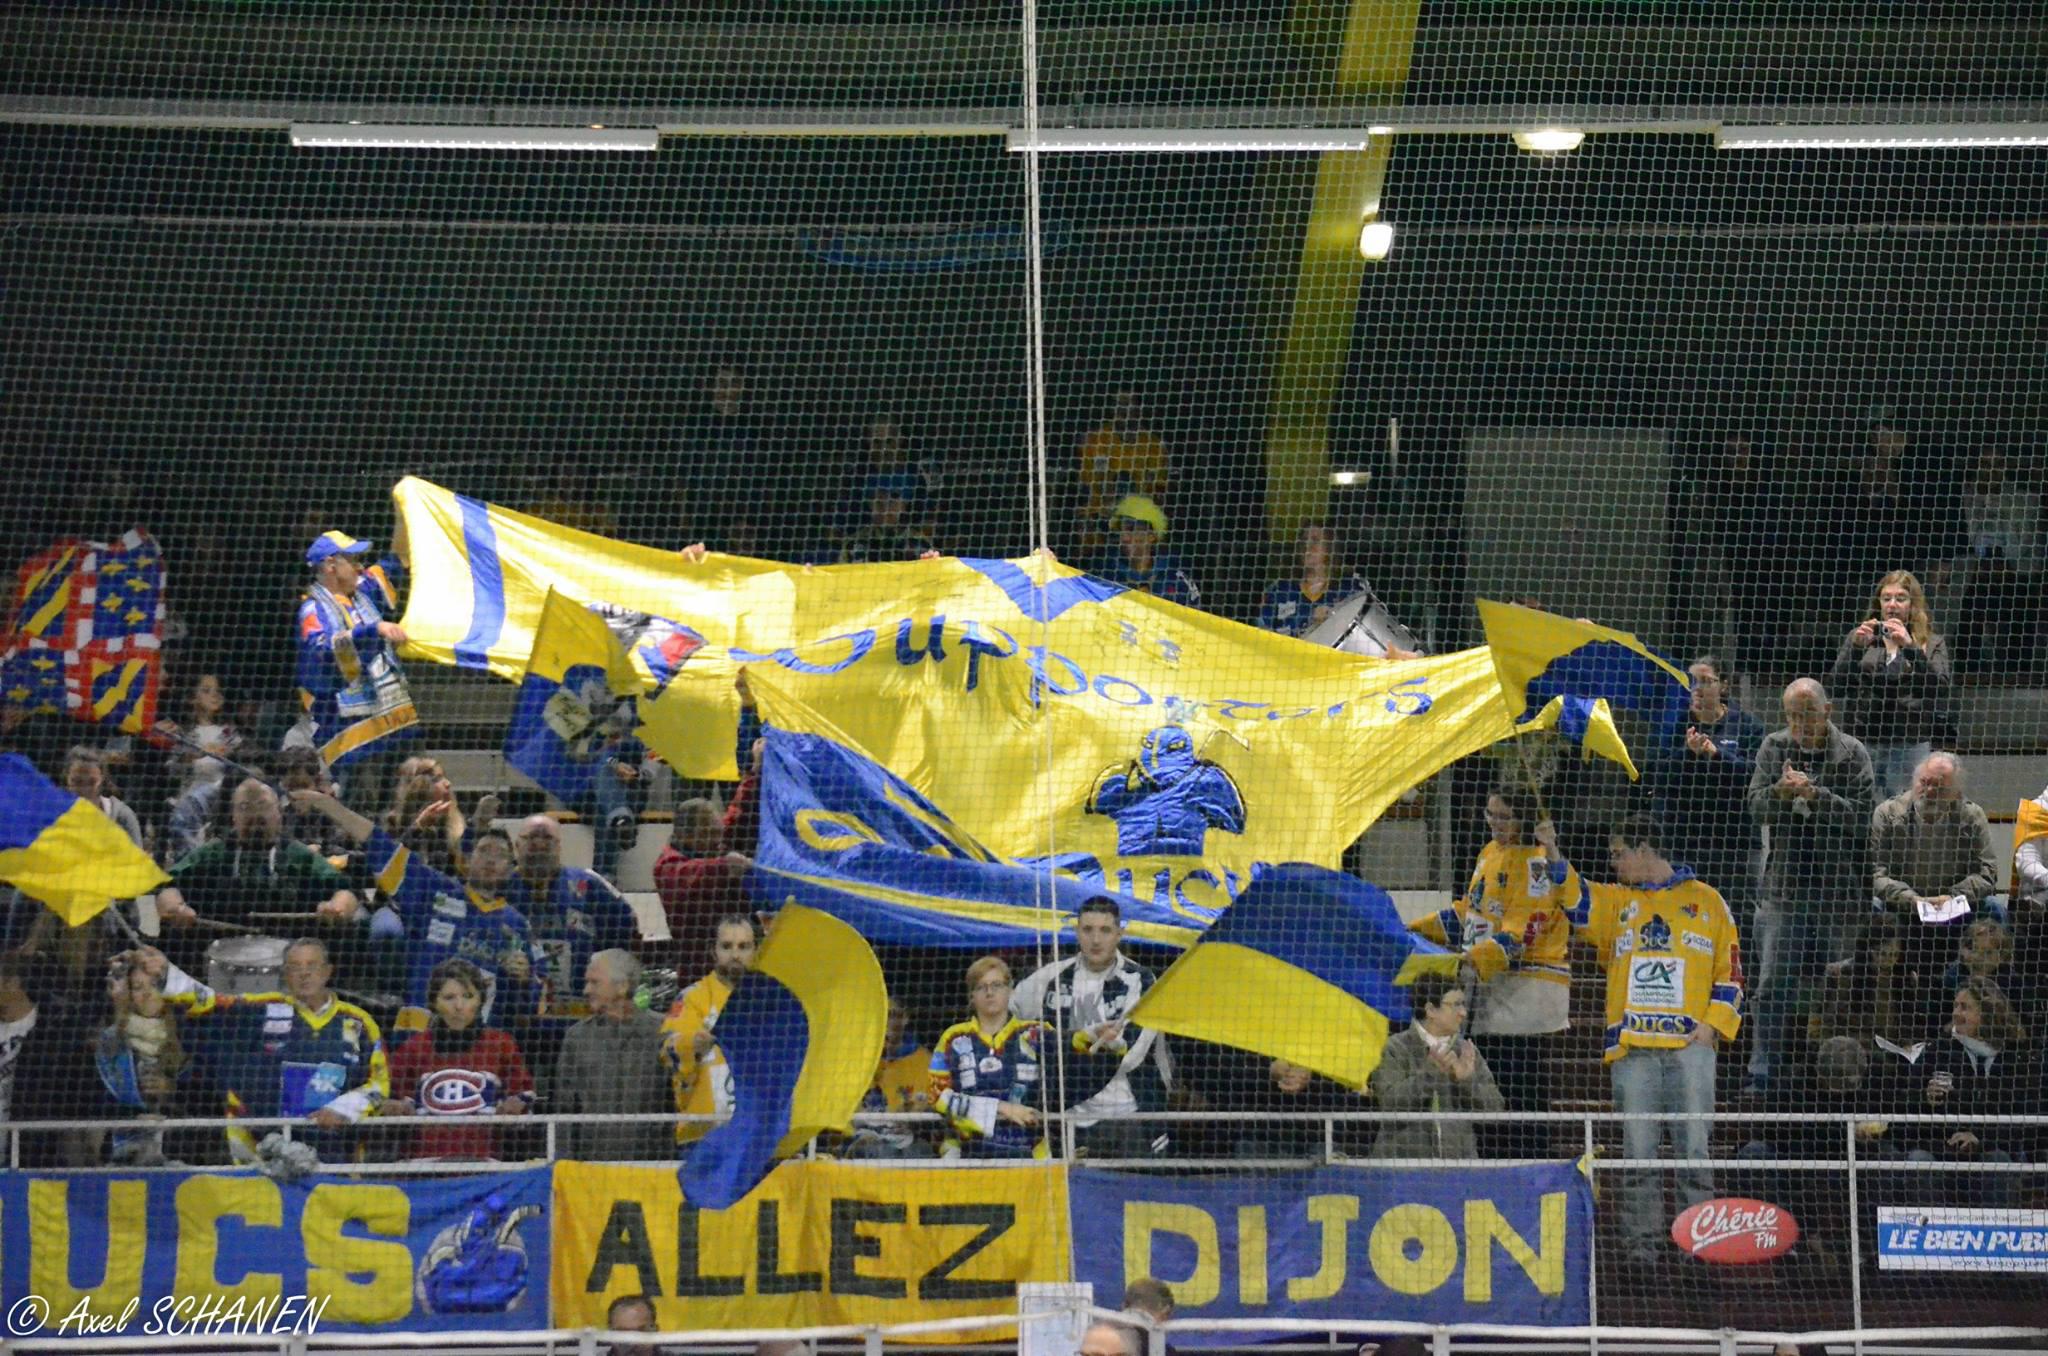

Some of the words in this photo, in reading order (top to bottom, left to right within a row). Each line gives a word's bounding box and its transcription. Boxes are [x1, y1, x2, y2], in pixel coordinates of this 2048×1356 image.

[1628, 1013, 1686, 1033] DUCS
[586, 1198, 1017, 1301] ALLEZ
[1123, 1191, 1567, 1305] DIJON
[1888, 1229, 1920, 1249] LE
[1923, 1229, 1985, 1251] BIEN
